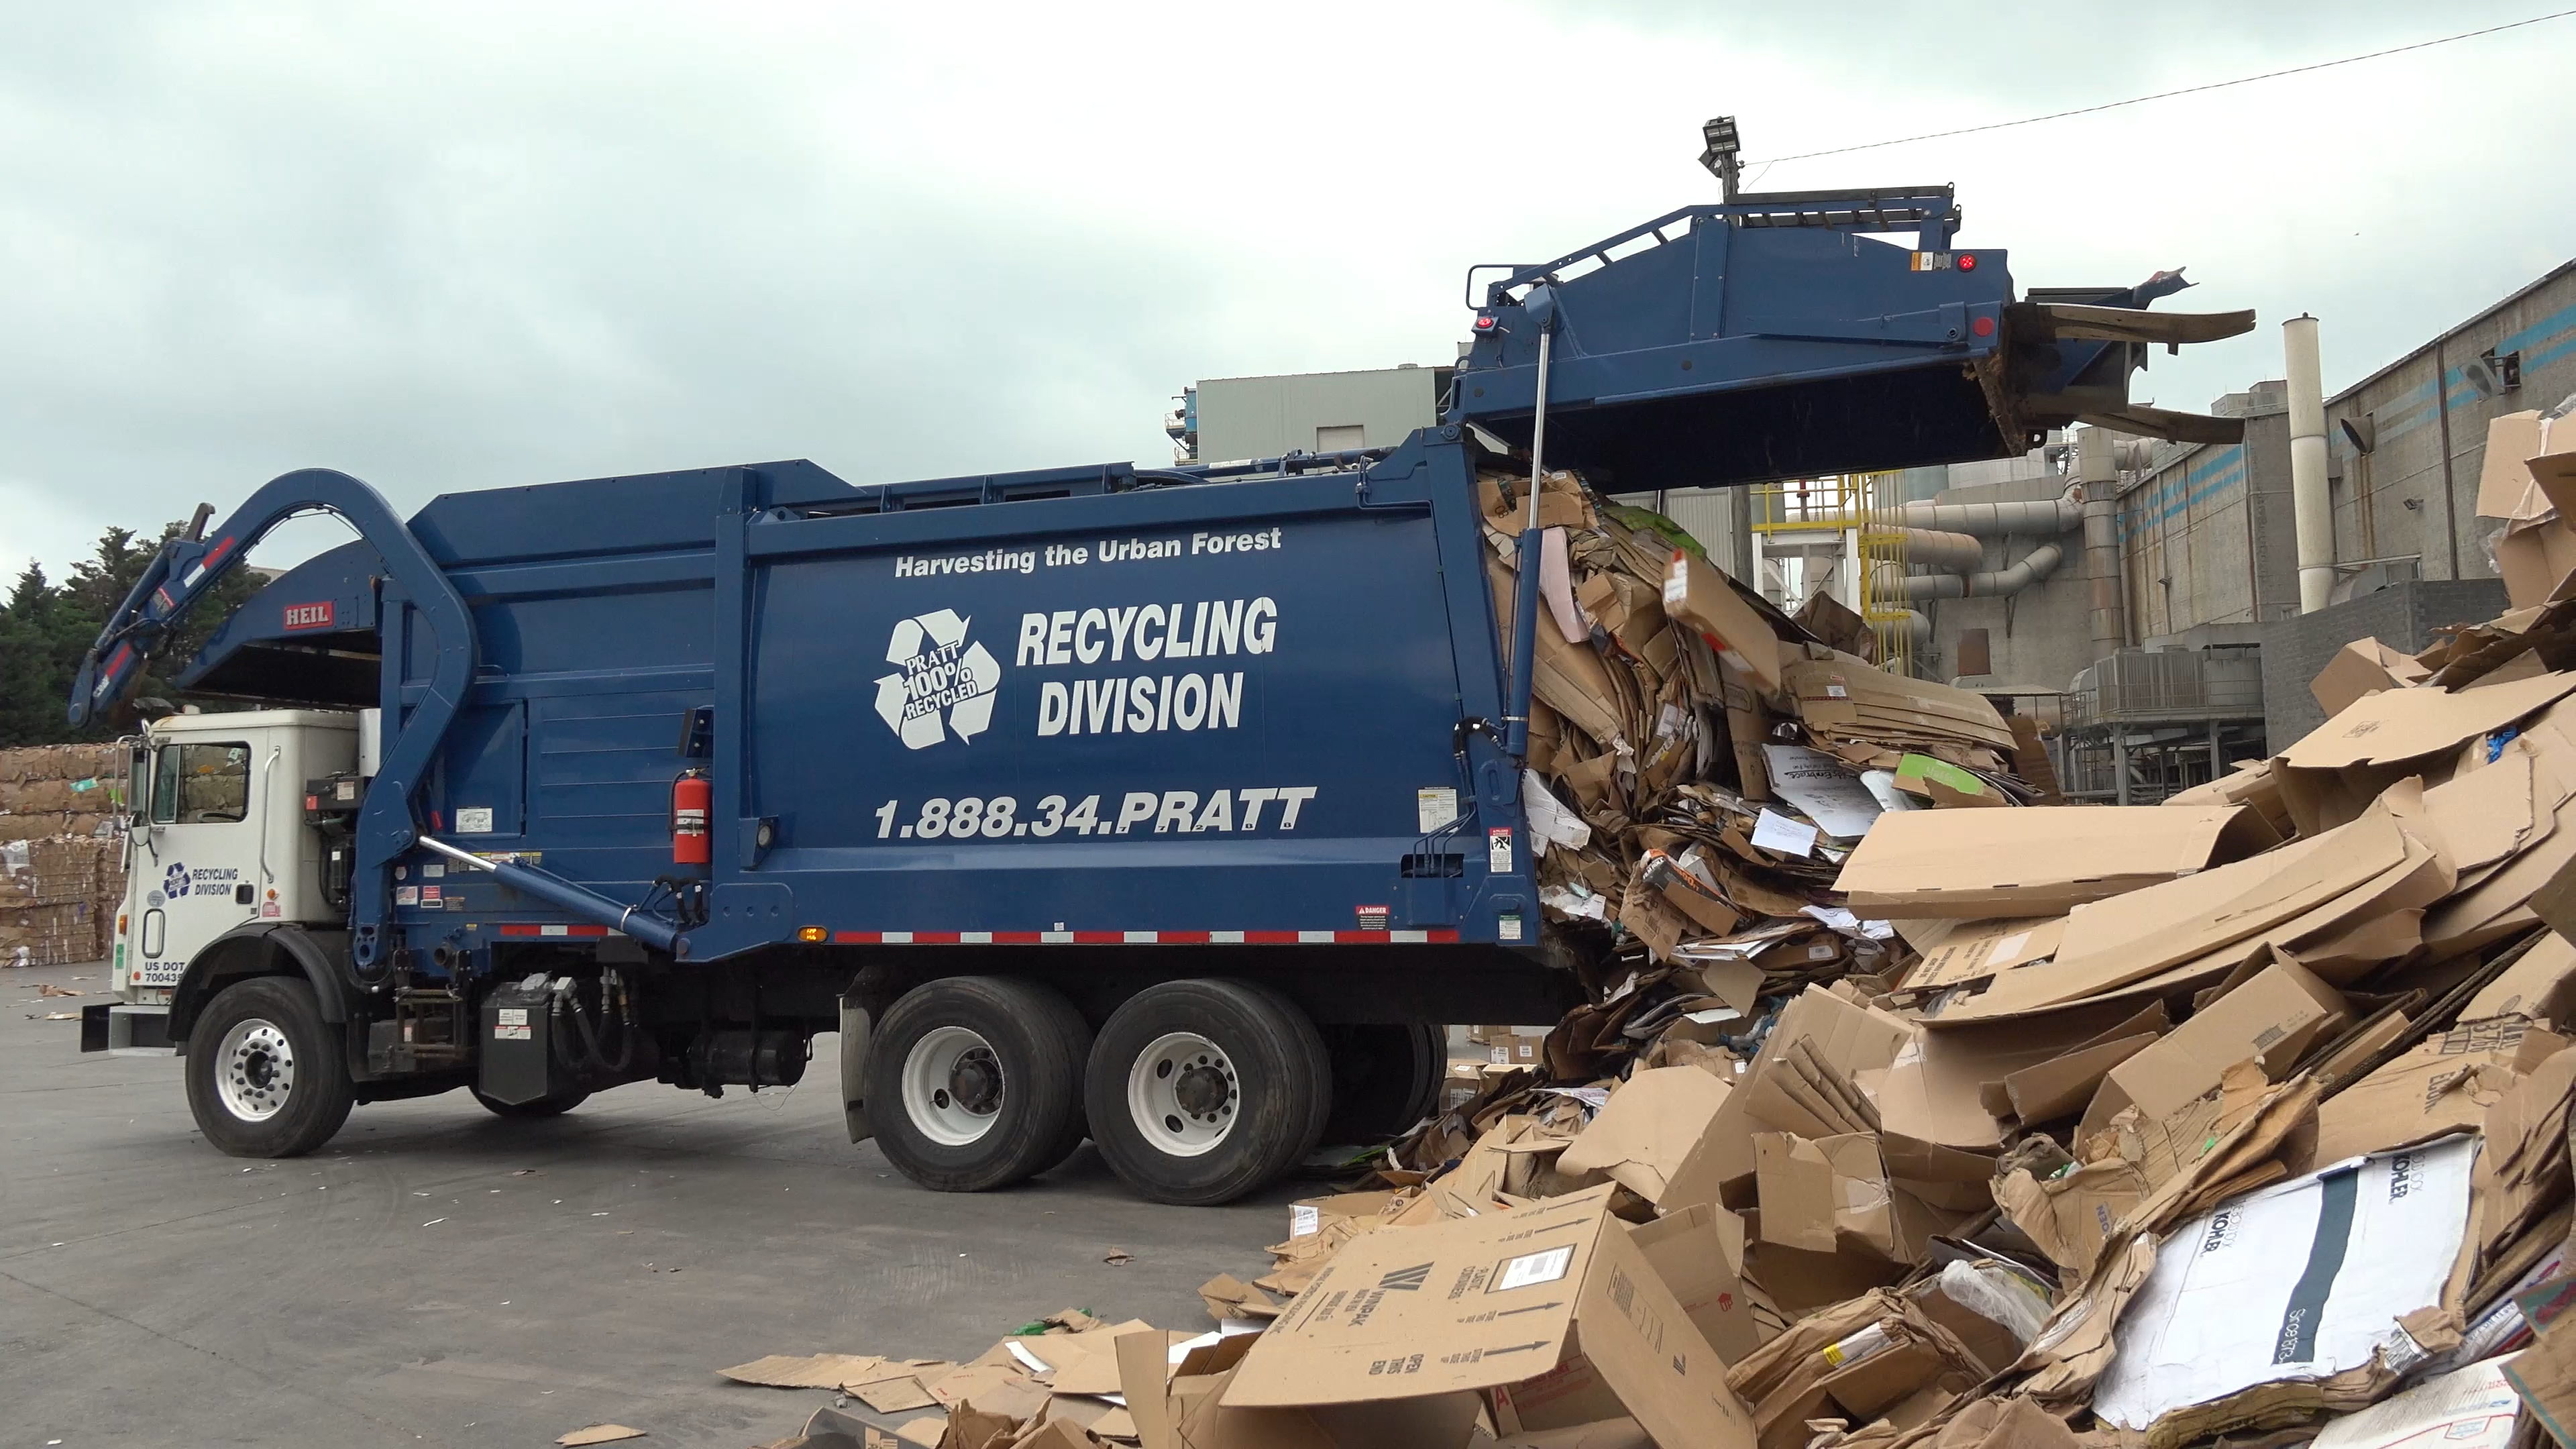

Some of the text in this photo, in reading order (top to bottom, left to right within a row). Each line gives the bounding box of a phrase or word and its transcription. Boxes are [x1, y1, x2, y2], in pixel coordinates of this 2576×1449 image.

[895, 528, 1282, 578] Harvesting the Urban Forest
[286, 606, 329, 625] HEIL
[1015, 596, 1278, 667] RECYCLING
[905, 640, 959, 675] PRATT
[903, 657, 973, 701] 100%
[905, 680, 978, 720] RECYCLED
[1037, 672, 1244, 737] DIVISION
[875, 786, 1318, 839] 1.888.34.PRATT
[192, 868, 239, 880] RECYCLING
[195, 884, 232, 896] DIVISION
[146, 962, 185, 971] US DOT
[2389, 1153, 2411, 1204] KOHLER
[2096, 1205, 2110, 1232] OEN
[2200, 1211, 2232, 1256] KOHLER
[1447, 1265, 1476, 1299] CONTAINERS
[1467, 1266, 1489, 1291] PLASTIC
[1347, 1289, 1387, 1327] WINPAK
[1719, 1300, 1733, 1312] UP
[2284, 1308, 2306, 1337] Since
[1368, 1360, 1387, 1375] END
[1386, 1356, 1406, 1375] THIS
[1405, 1354, 1424, 1374] OPEN
